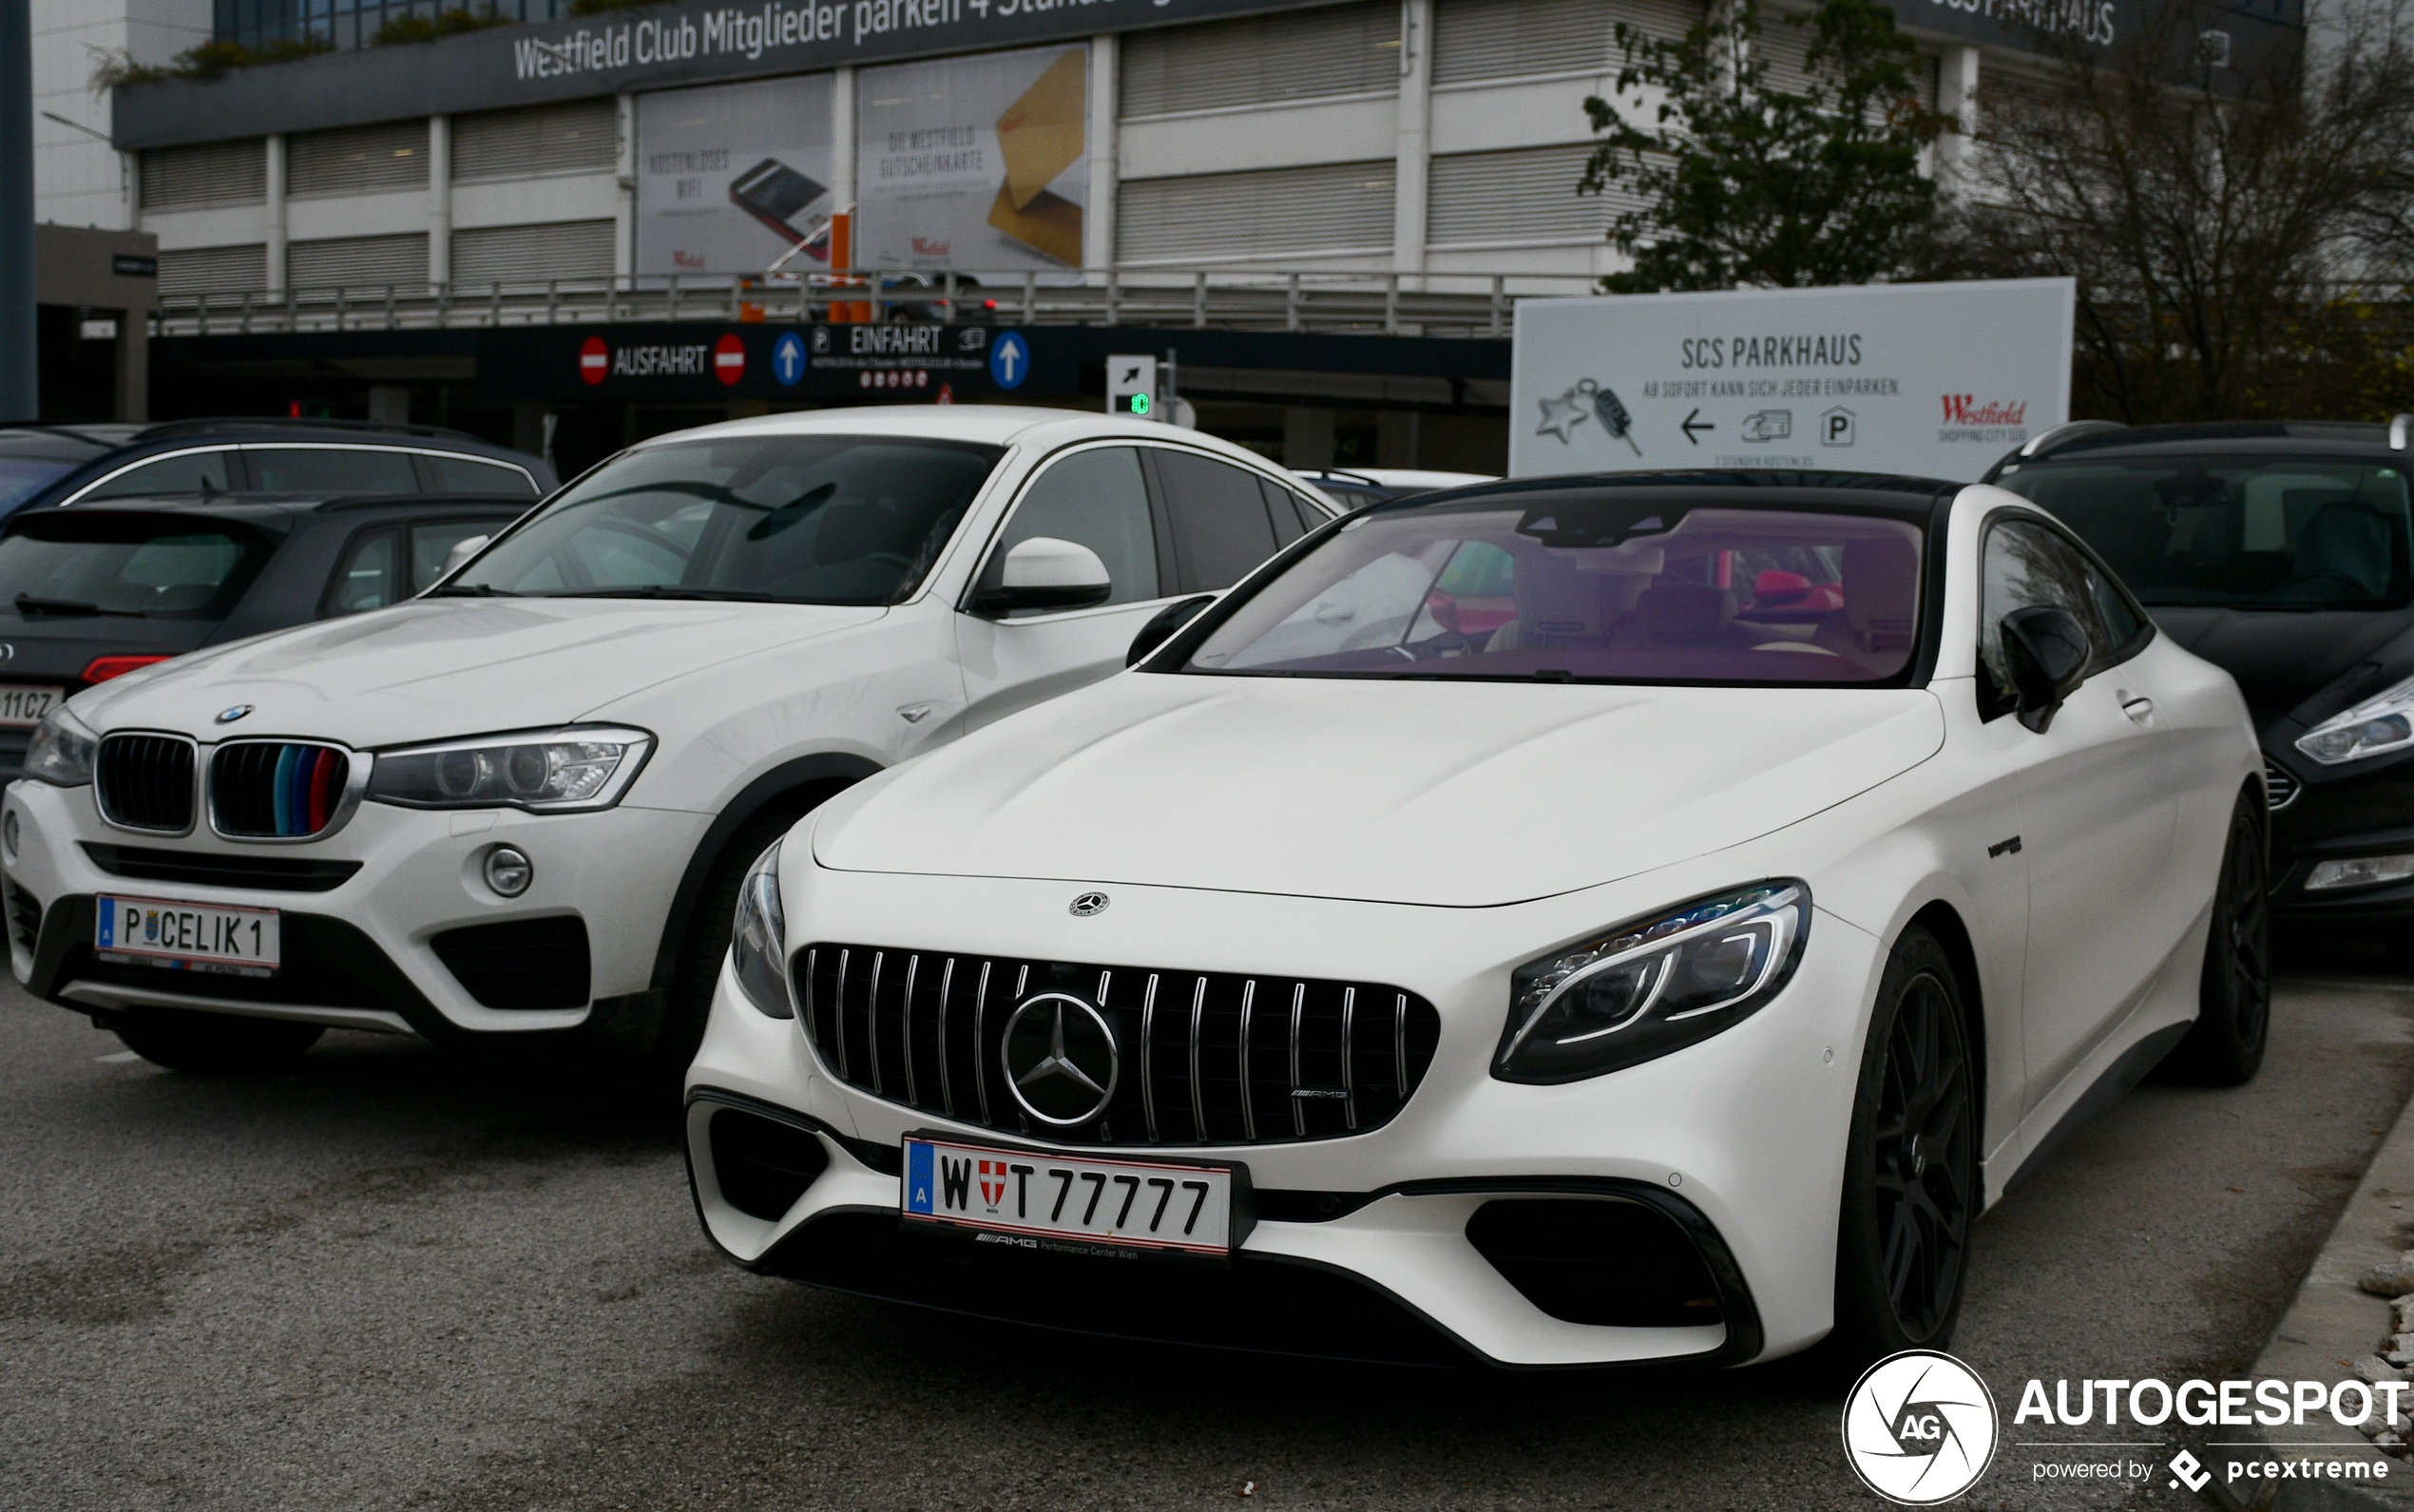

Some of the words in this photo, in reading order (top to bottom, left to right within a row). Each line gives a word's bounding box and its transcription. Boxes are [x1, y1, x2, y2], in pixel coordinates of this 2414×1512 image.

[514, 24, 630, 80] Westfield
[635, 15, 697, 65] Club
[702, 0, 848, 60] Mitglieder
[853, 0, 961, 46] parken
[613, 335, 708, 375] AUSFAHRT
[851, 325, 943, 354] EINFAHRT
[1681, 336, 1724, 369] SCS
[1732, 333, 1862, 367] PARKHAUS
[1642, 380, 1660, 397] AB
[1661, 380, 1708, 397] SOFORT
[1710, 380, 1746, 397] KANN
[1747, 379, 1778, 397] SICH
[1780, 378, 1822, 396] JEDER
[1942, 393, 2029, 425] Westfield
[1938, 429, 1983, 444] SHOPPING
[125, 908, 140, 944] P
[162, 910, 240, 954] CELIK
[915, 1187, 927, 1204] A
[942, 1156, 971, 1211] W
[994, 1235, 1037, 1248] AMG
[1041, 1240, 1088, 1254] Performance
[1090, 1246, 1116, 1257] Center
[1119, 1250, 1138, 1259] Wien
